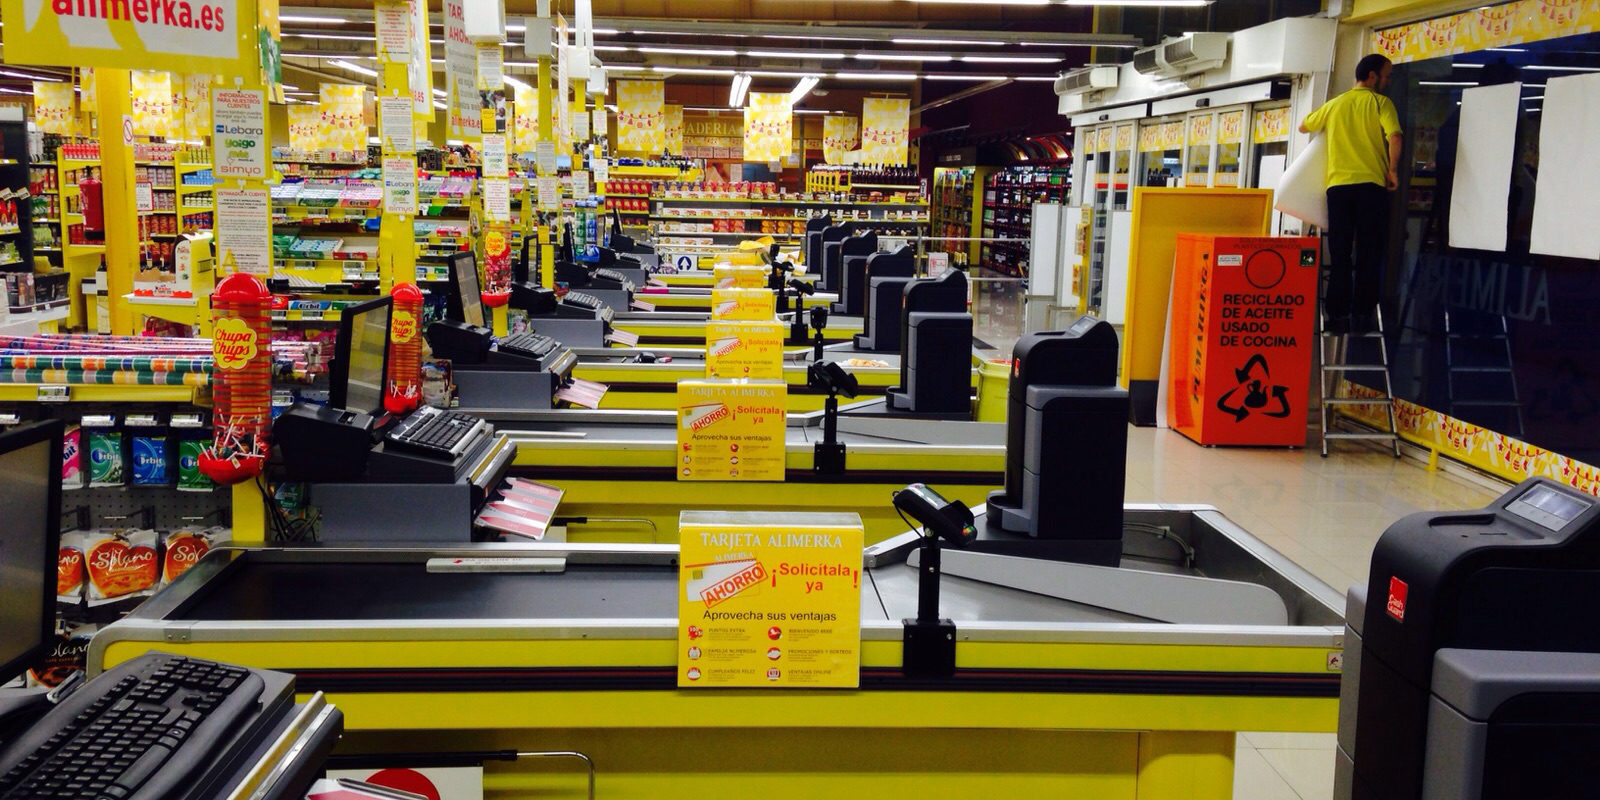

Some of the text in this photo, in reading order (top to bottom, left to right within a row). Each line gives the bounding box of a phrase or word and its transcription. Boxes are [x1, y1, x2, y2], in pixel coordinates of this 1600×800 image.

[225, 126, 263, 135] Lebara
[224, 139, 256, 149] yoigo
[220, 165, 261, 176] simyo
[1223, 294, 1305, 306] RECICLADO
[1222, 308, 1294, 320] DE ACEITE
[1221, 322, 1270, 334] USADO
[215, 328, 252, 344] Chupa
[1220, 336, 1298, 348] DE COCINA
[213, 342, 250, 362] Chups
[716, 340, 743, 358] AHORRO
[690, 387, 774, 398] TARJETA ALIMERKA
[692, 406, 729, 432] AHORRO
[752, 416, 764, 424] ya
[692, 434, 728, 442] Aprovecha
[743, 434, 772, 443] ventajas
[141, 456, 163, 465] Orbit
[700, 532, 842, 550] TARJETA ALIMERKA
[95, 549, 152, 569] Solano
[706, 564, 765, 606] AHORRO
[806, 582, 824, 595] ya
[703, 610, 837, 623] Aprovecha sus ventajas
